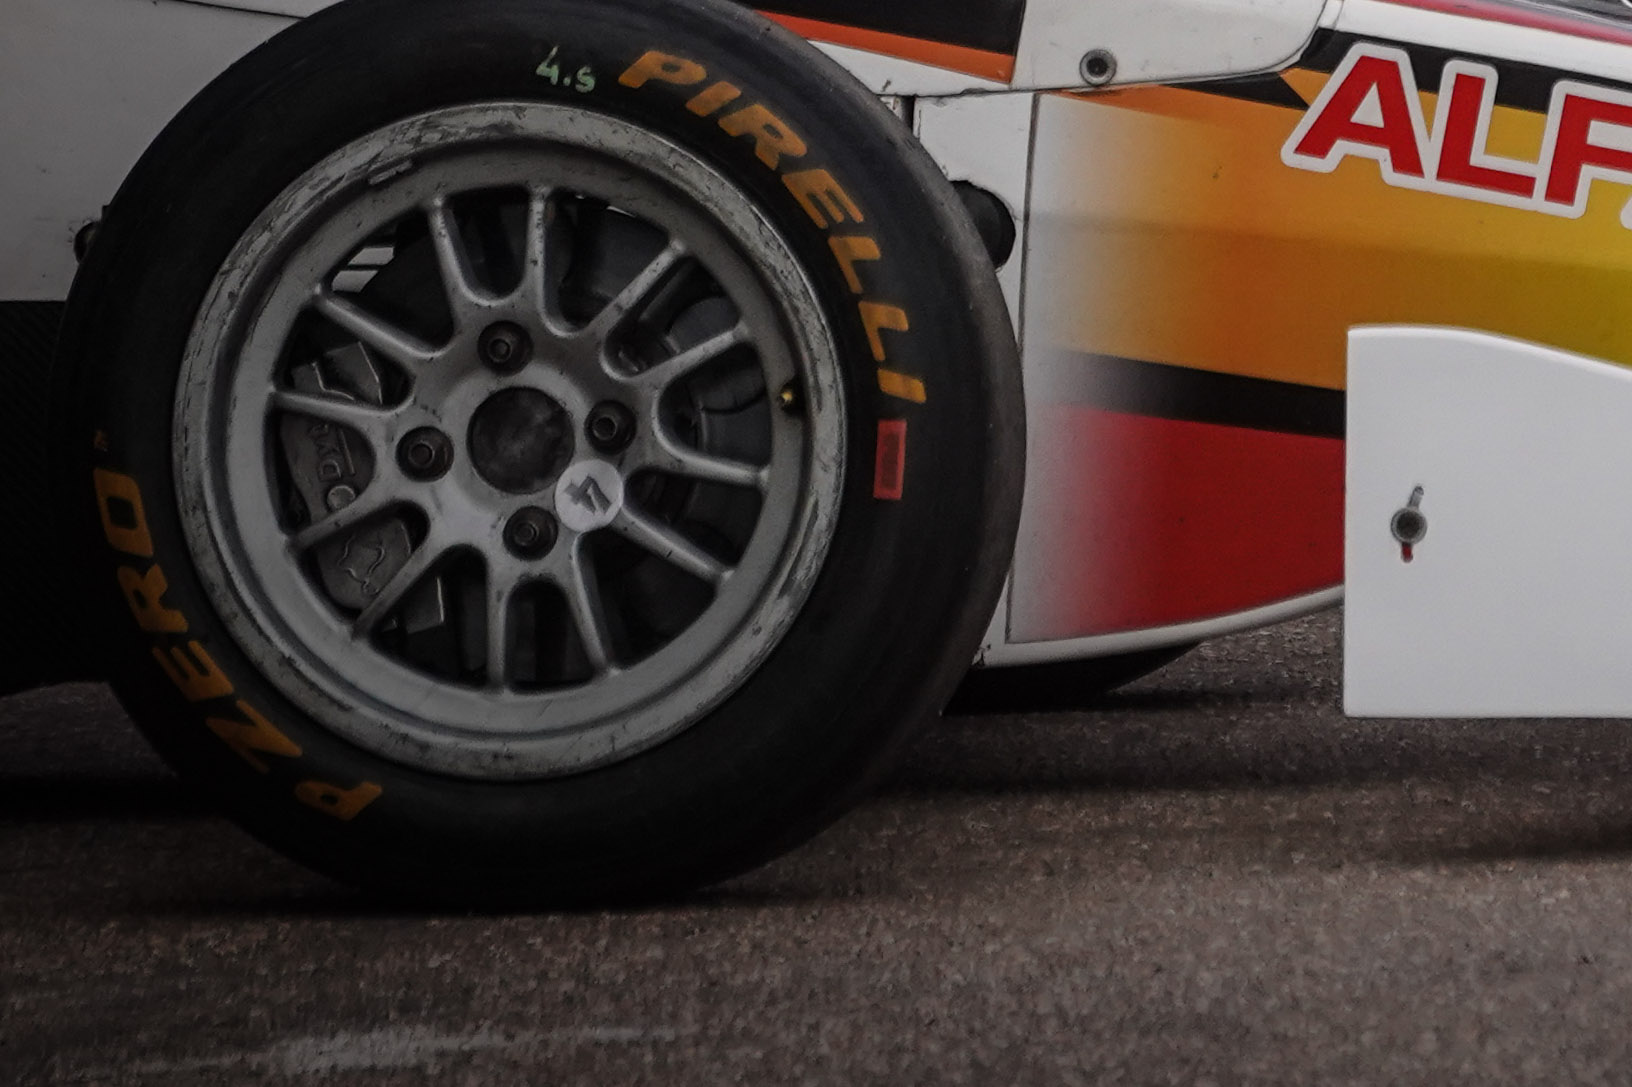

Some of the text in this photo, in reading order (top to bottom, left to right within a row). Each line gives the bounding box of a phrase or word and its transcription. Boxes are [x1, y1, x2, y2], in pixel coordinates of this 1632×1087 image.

[618, 50, 927, 404] PIRELLI
[93, 466, 383, 822] P ZERO
